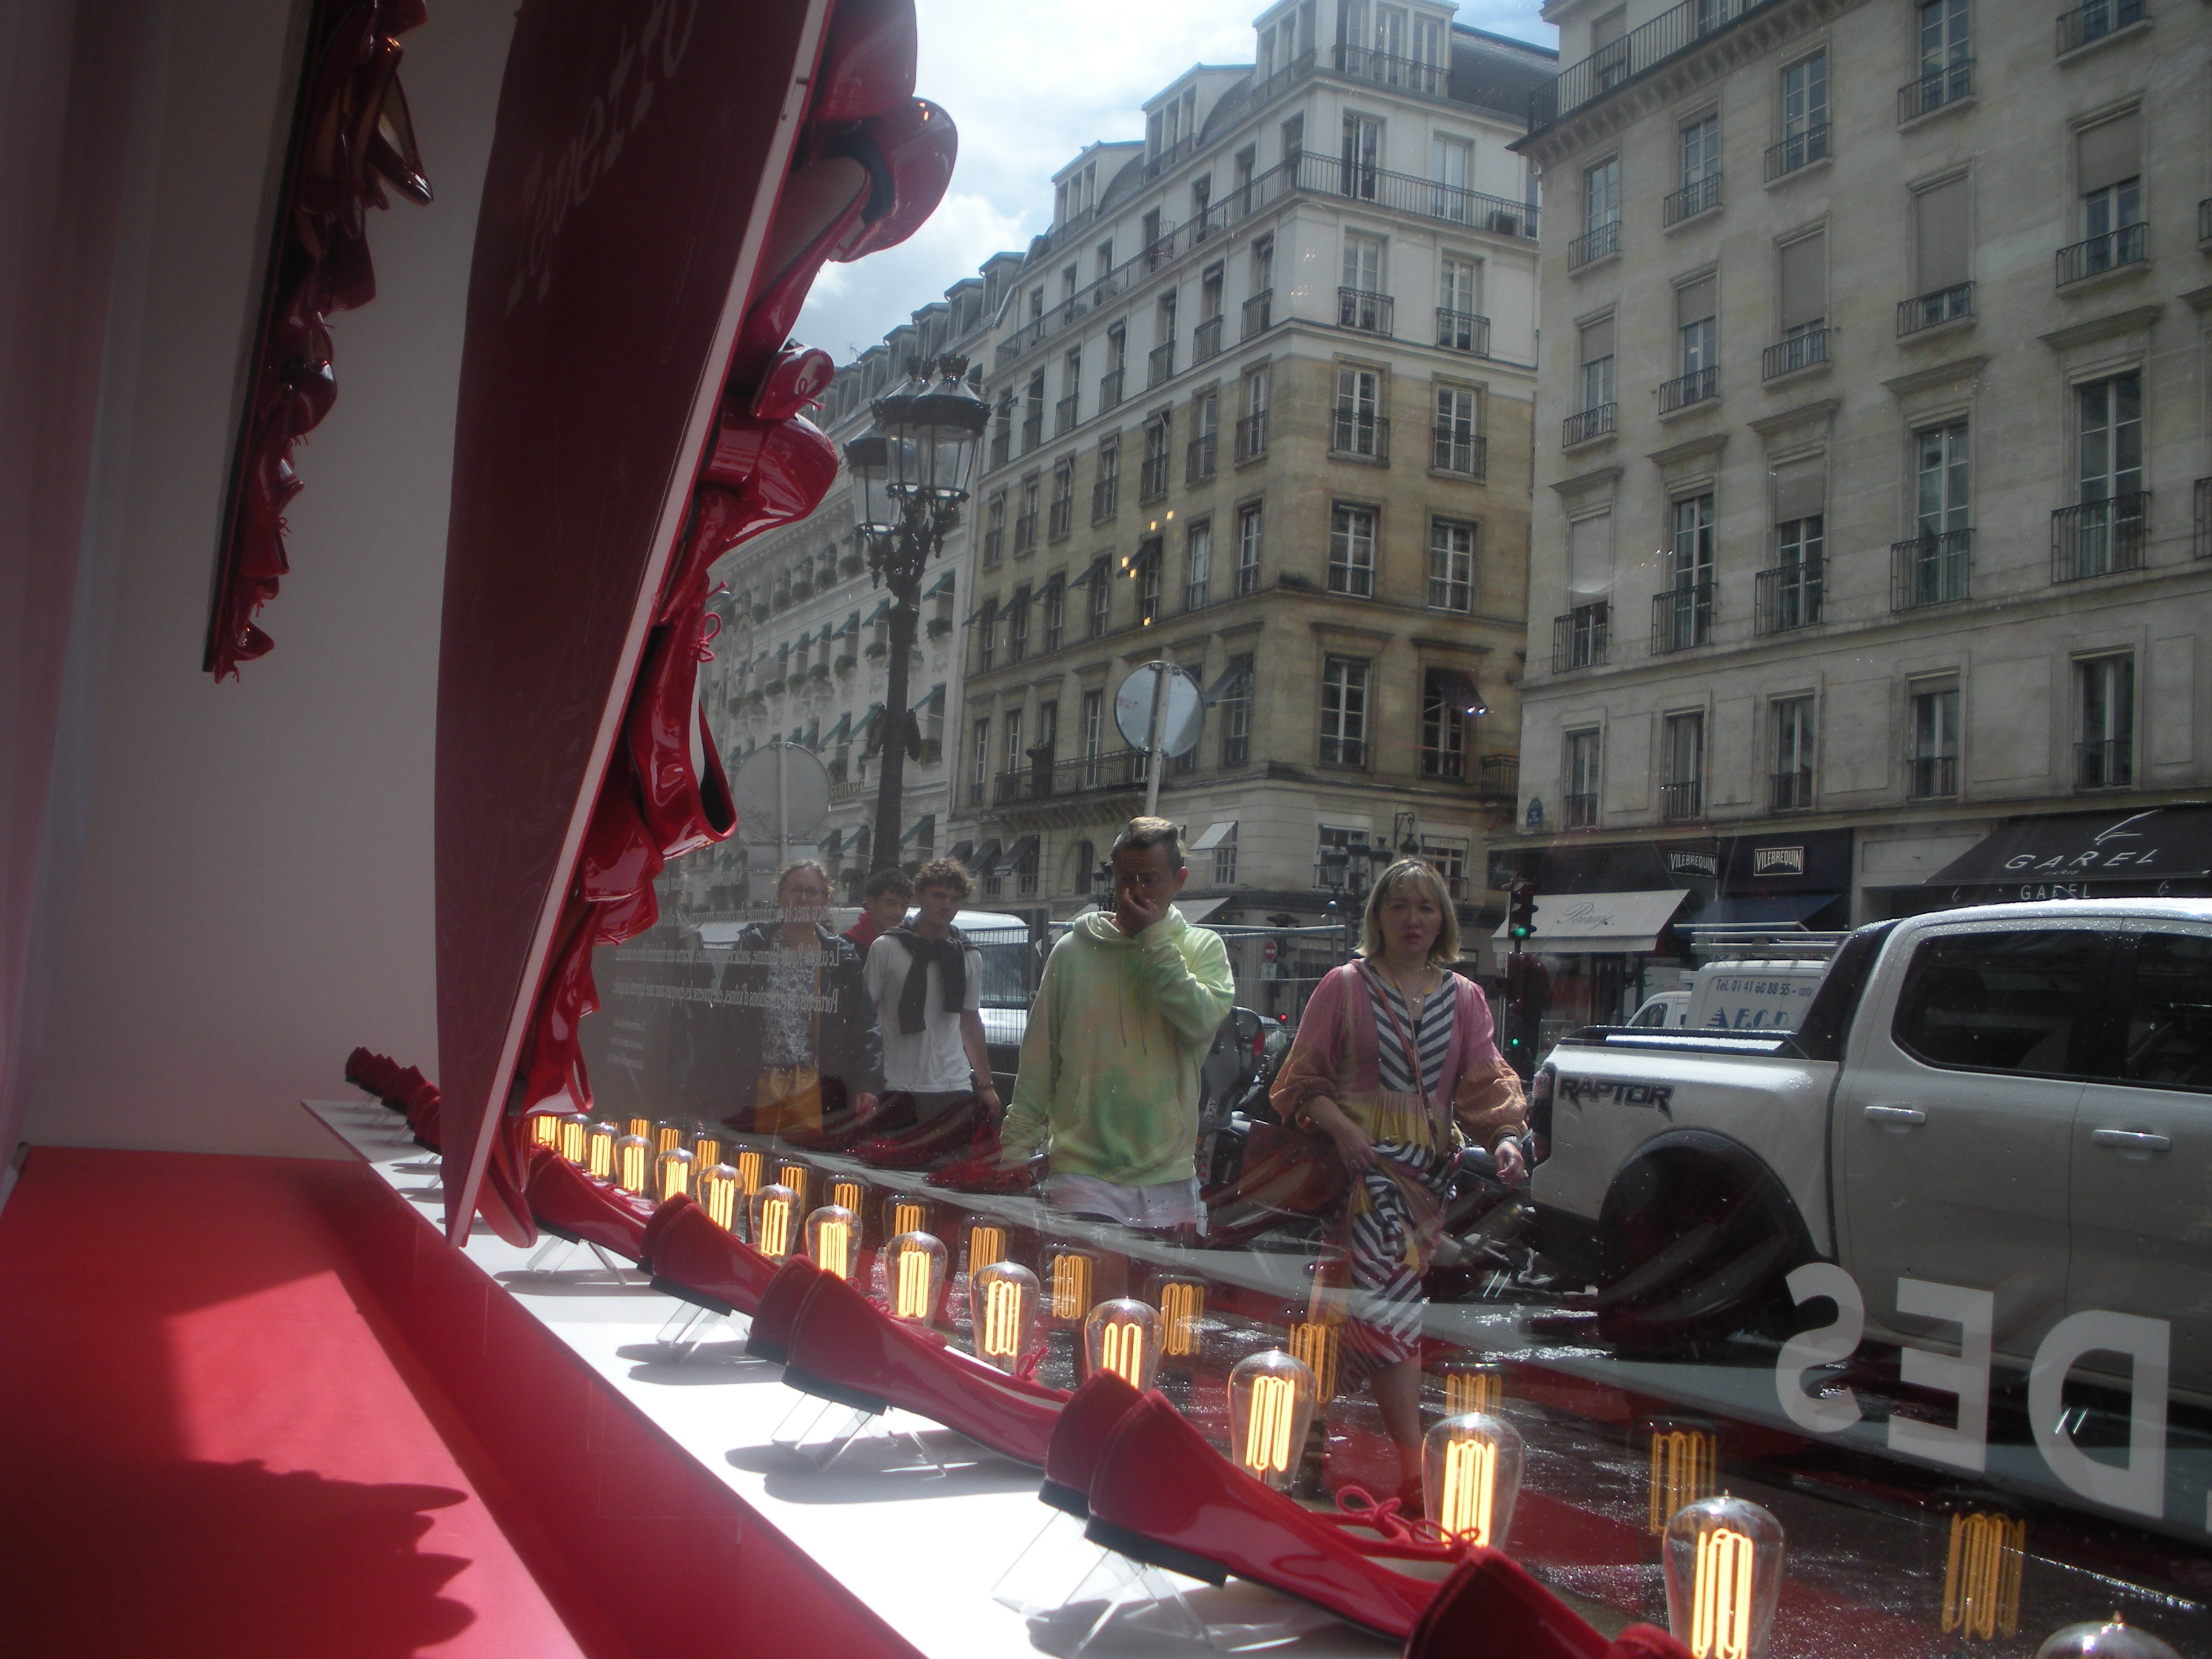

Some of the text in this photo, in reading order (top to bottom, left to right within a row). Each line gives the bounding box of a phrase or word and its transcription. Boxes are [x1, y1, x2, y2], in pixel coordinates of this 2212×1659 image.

[1671, 853, 1717, 875] VILEBREQUIN
[1757, 849, 1802, 873] VILEBREQUIN
[2005, 849, 2157, 869] GAREL
[1558, 1076, 1675, 1122] RAPTOR
